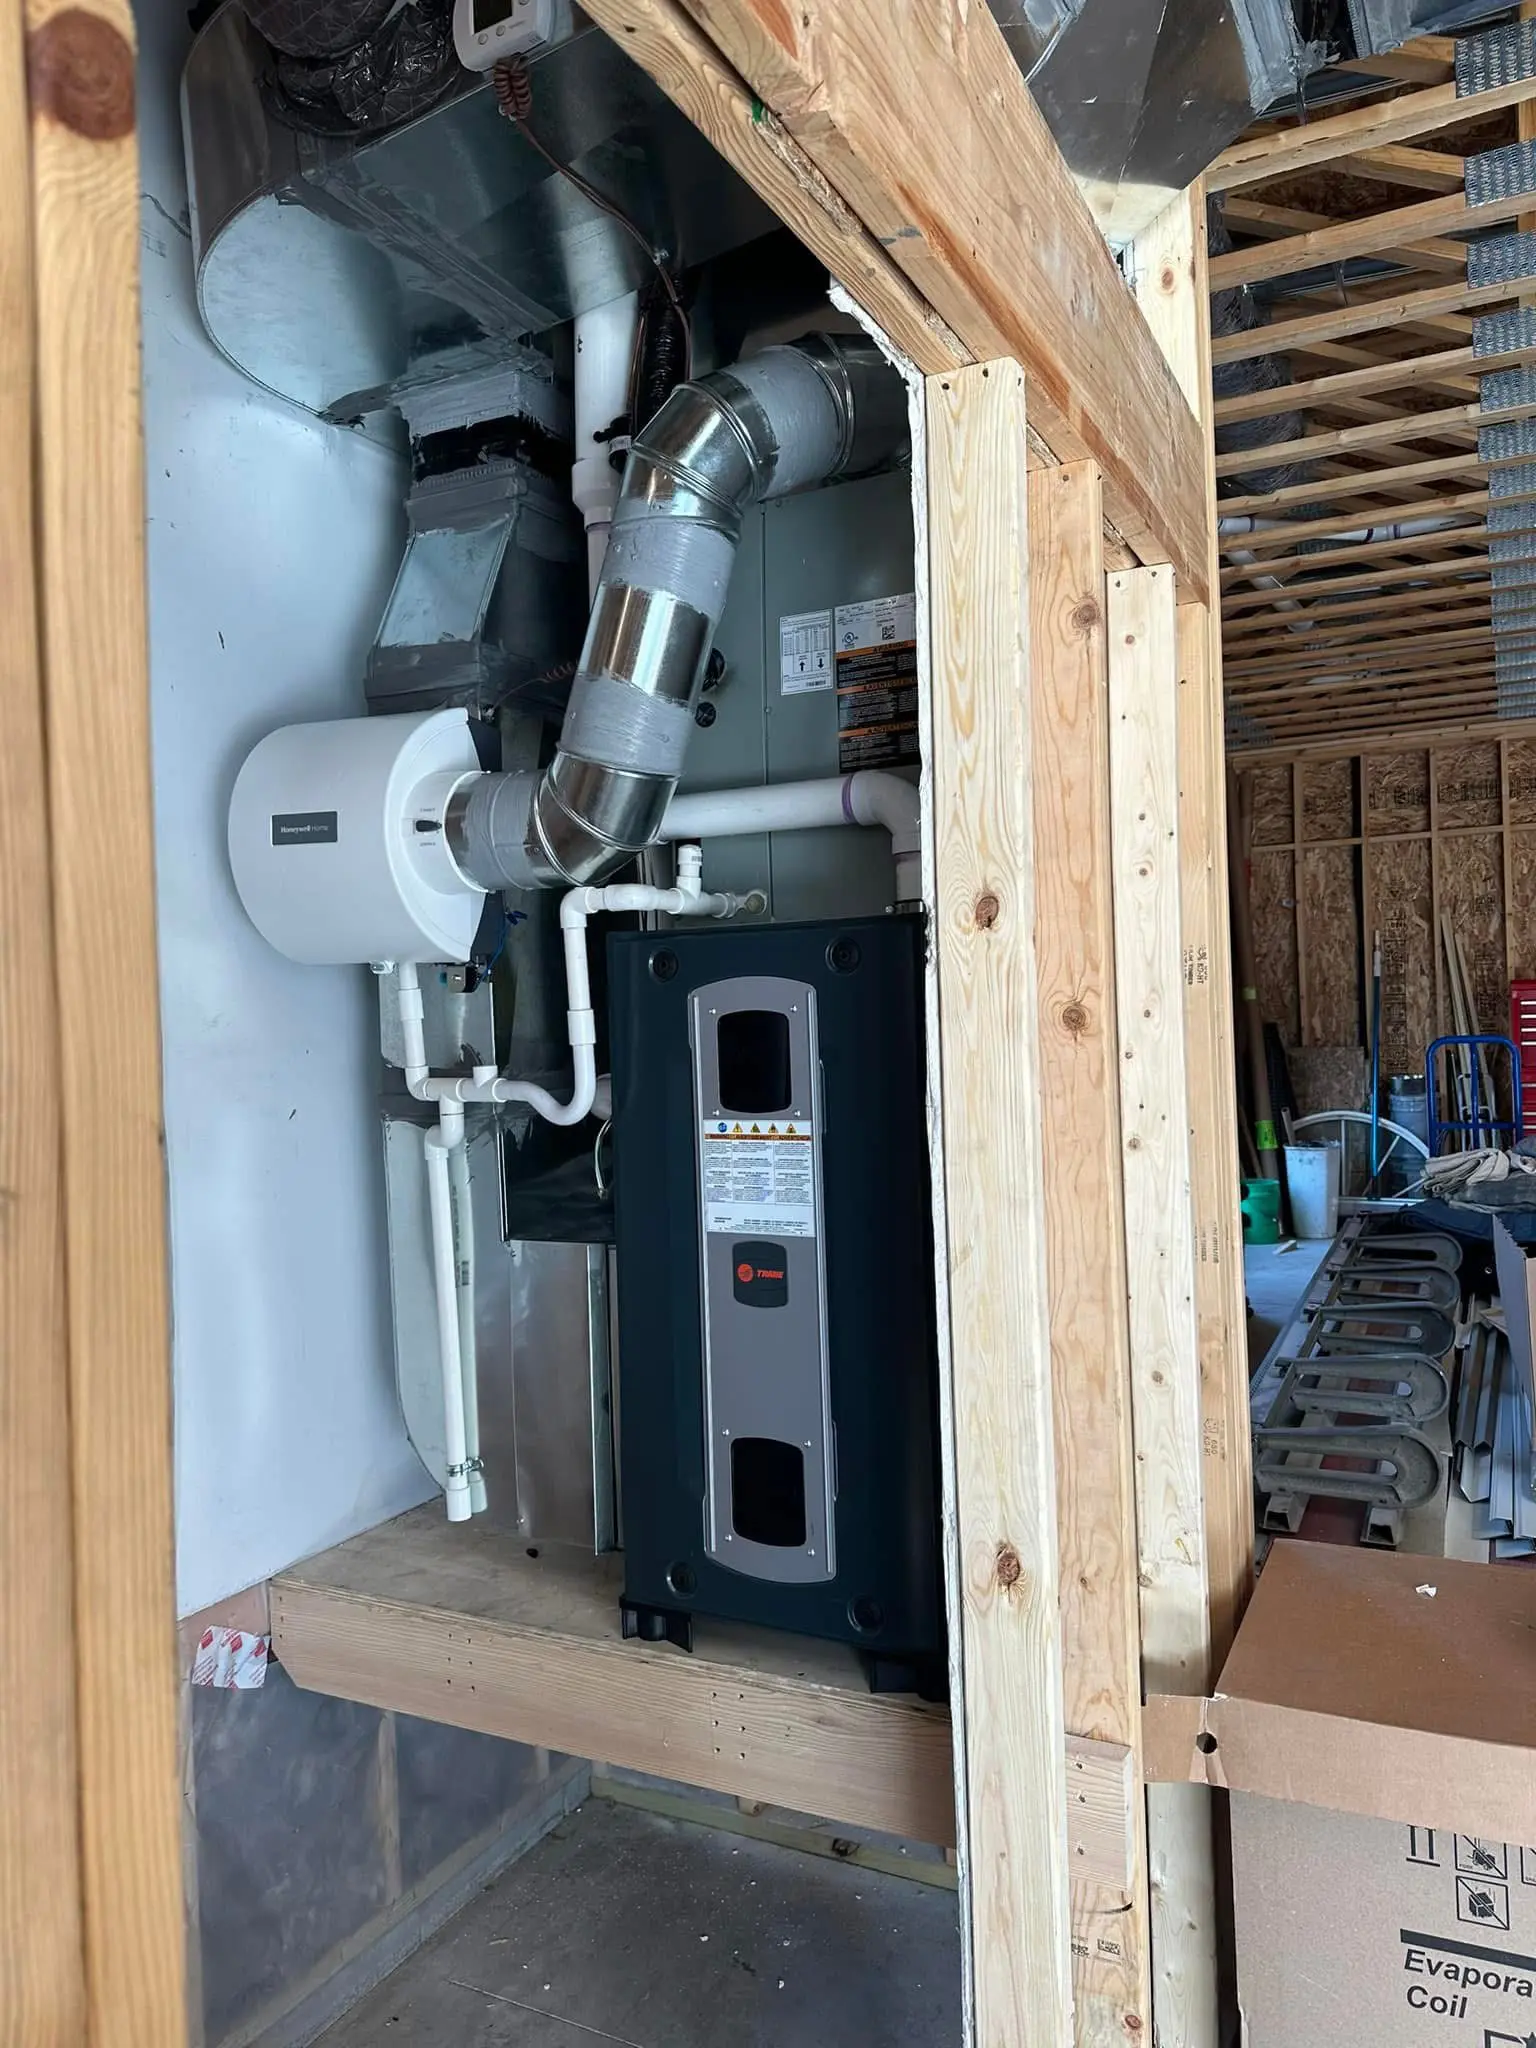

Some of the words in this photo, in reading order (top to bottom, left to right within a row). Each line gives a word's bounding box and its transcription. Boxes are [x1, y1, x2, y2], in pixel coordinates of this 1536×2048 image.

[280, 824, 310, 835] Honeywell
[757, 1269, 784, 1279] TRANE
[1404, 1949, 1533, 1998] Evapora
[1406, 1985, 1467, 2019] Coil
